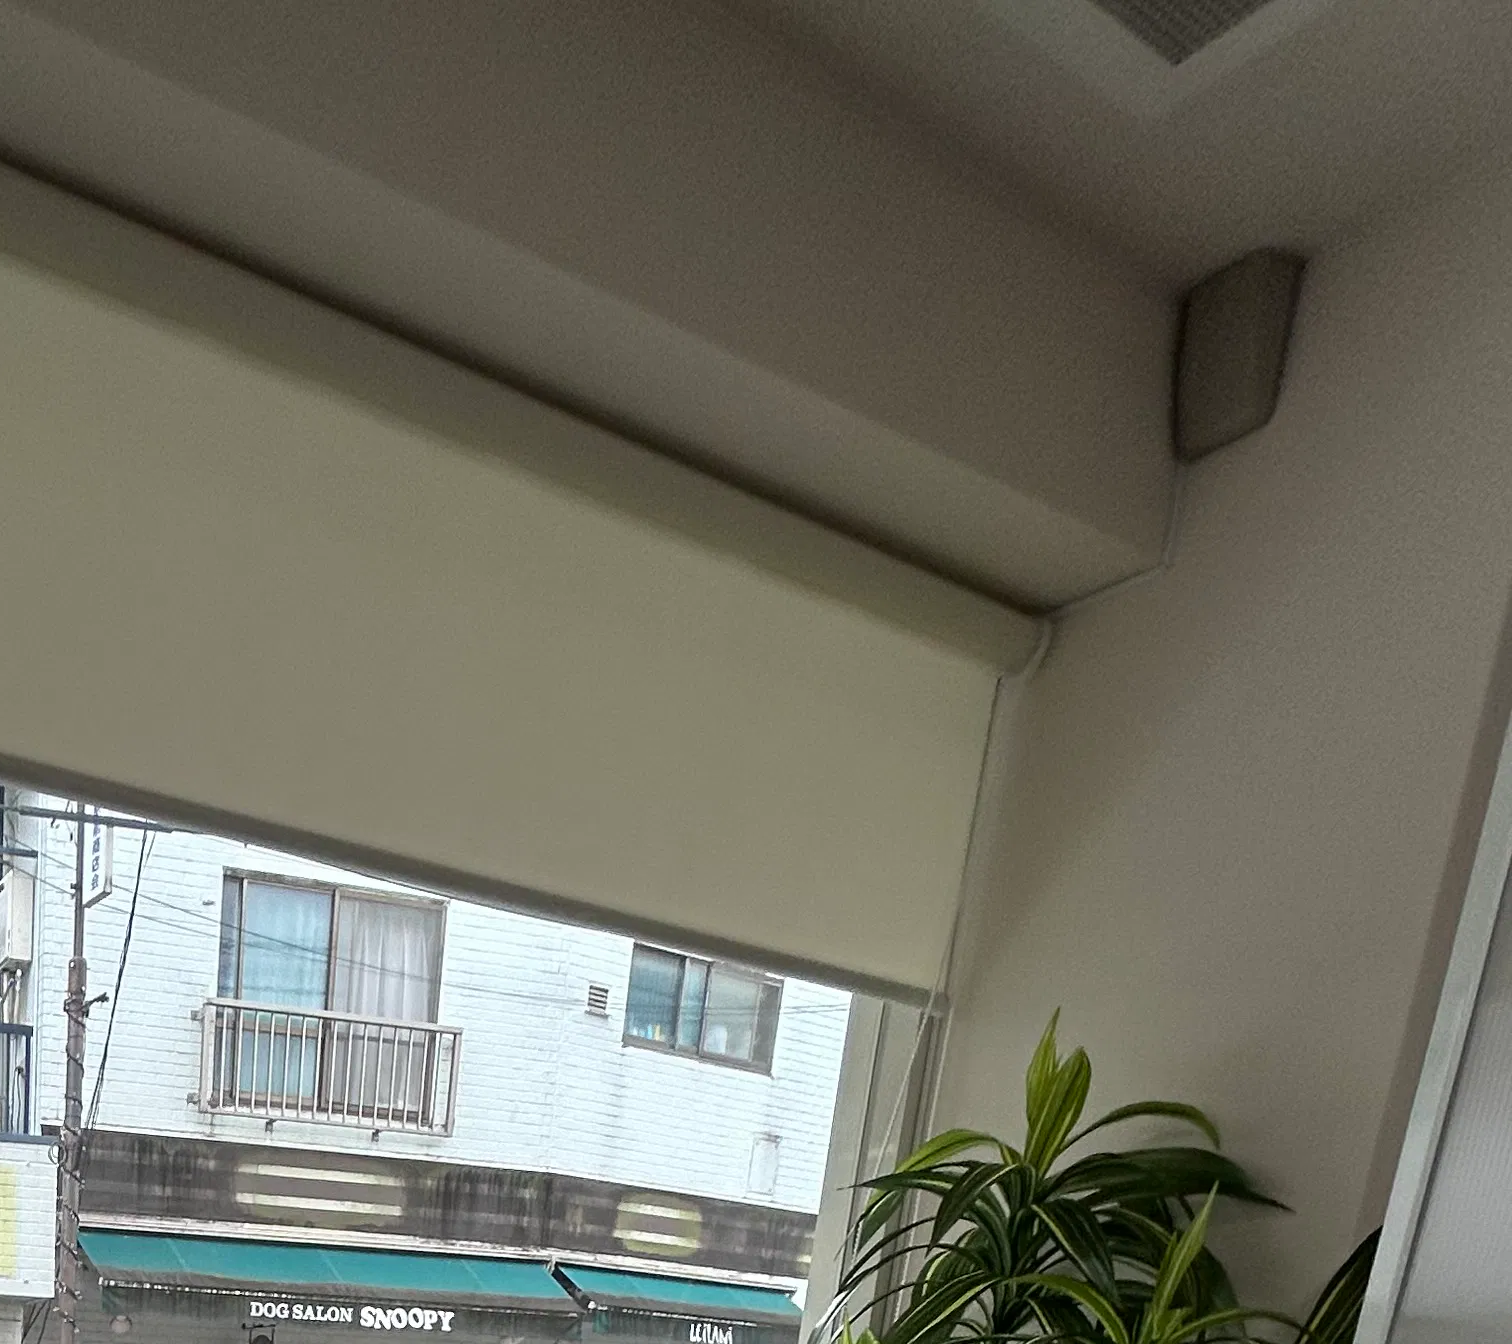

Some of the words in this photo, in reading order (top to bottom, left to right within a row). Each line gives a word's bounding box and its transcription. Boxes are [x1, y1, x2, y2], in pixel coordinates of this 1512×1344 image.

[249, 1301, 290, 1319] DOG
[292, 1303, 354, 1323] SALON
[359, 1305, 456, 1332] SNOOPY
